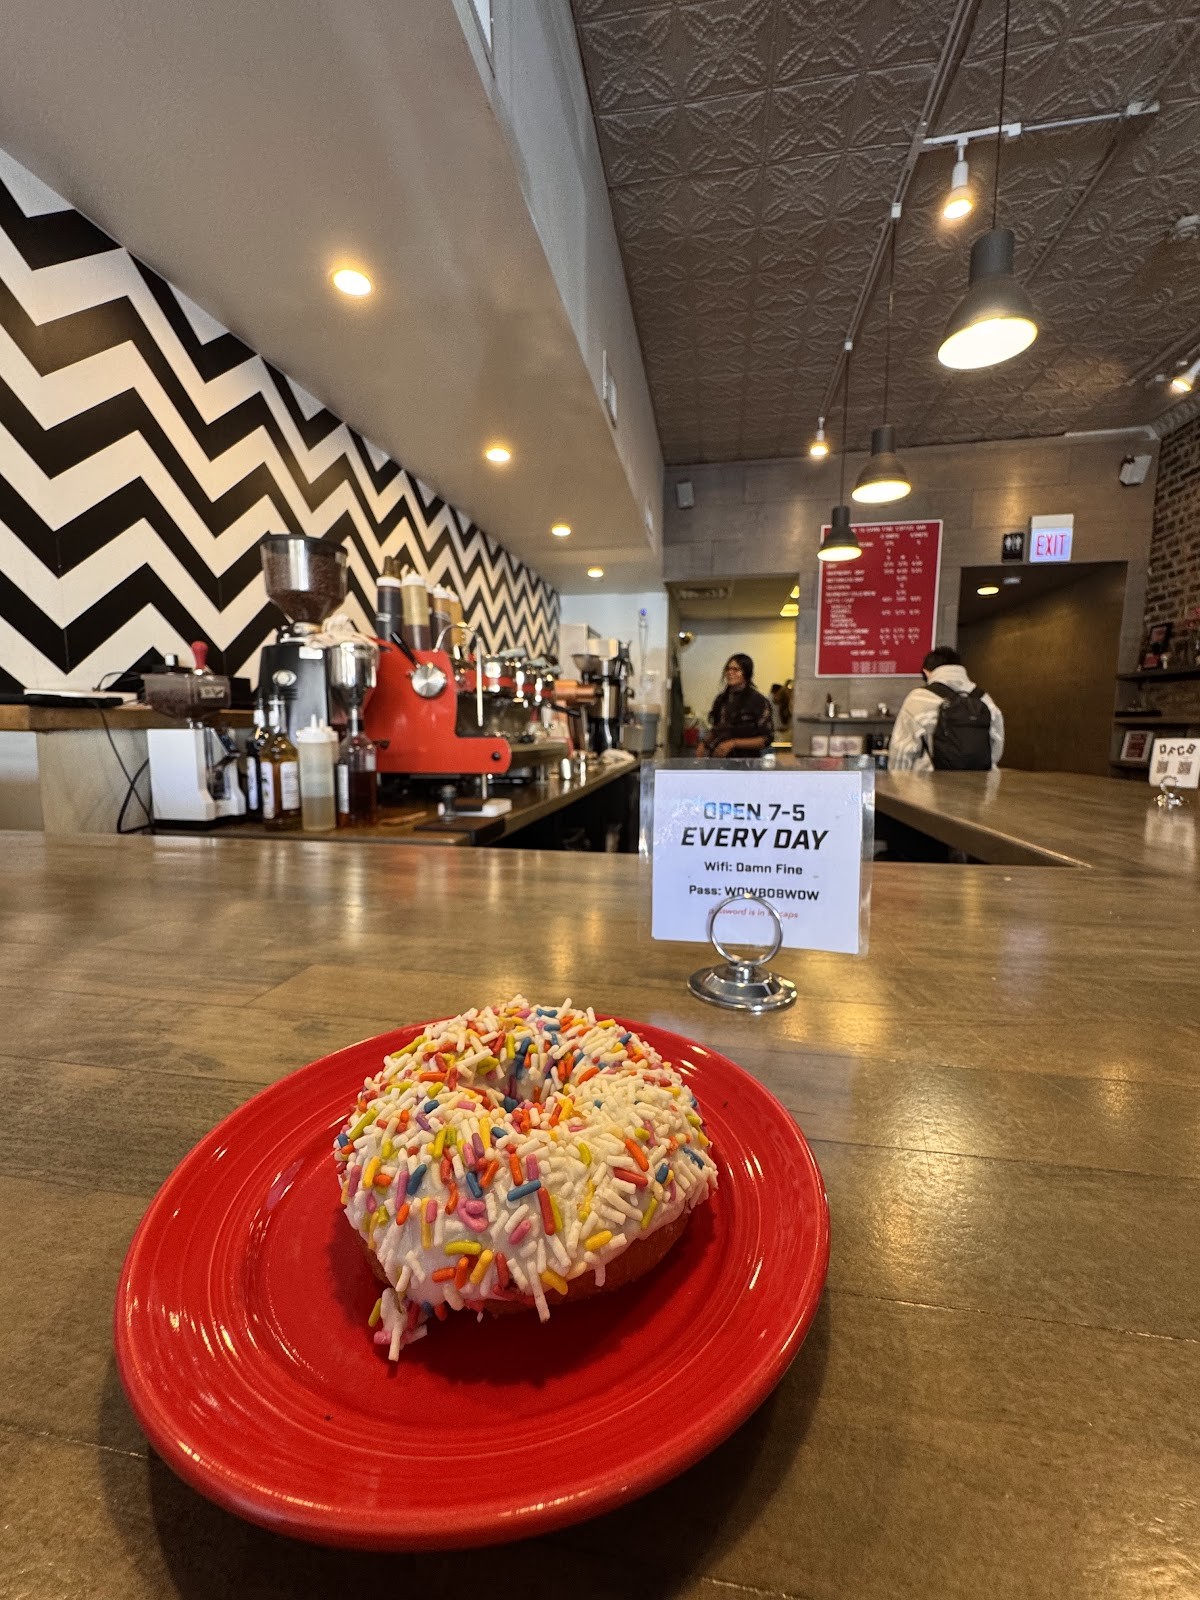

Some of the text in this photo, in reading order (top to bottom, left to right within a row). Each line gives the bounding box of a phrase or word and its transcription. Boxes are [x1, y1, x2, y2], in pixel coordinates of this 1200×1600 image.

[1036, 534, 1066, 556] EXIT
[703, 802, 806, 822] OPEN 7-5
[681, 826, 829, 850] EVERY DAY
[704, 861, 803, 875] Wifi: Damn Fine
[689, 885, 722, 896] Pass:
